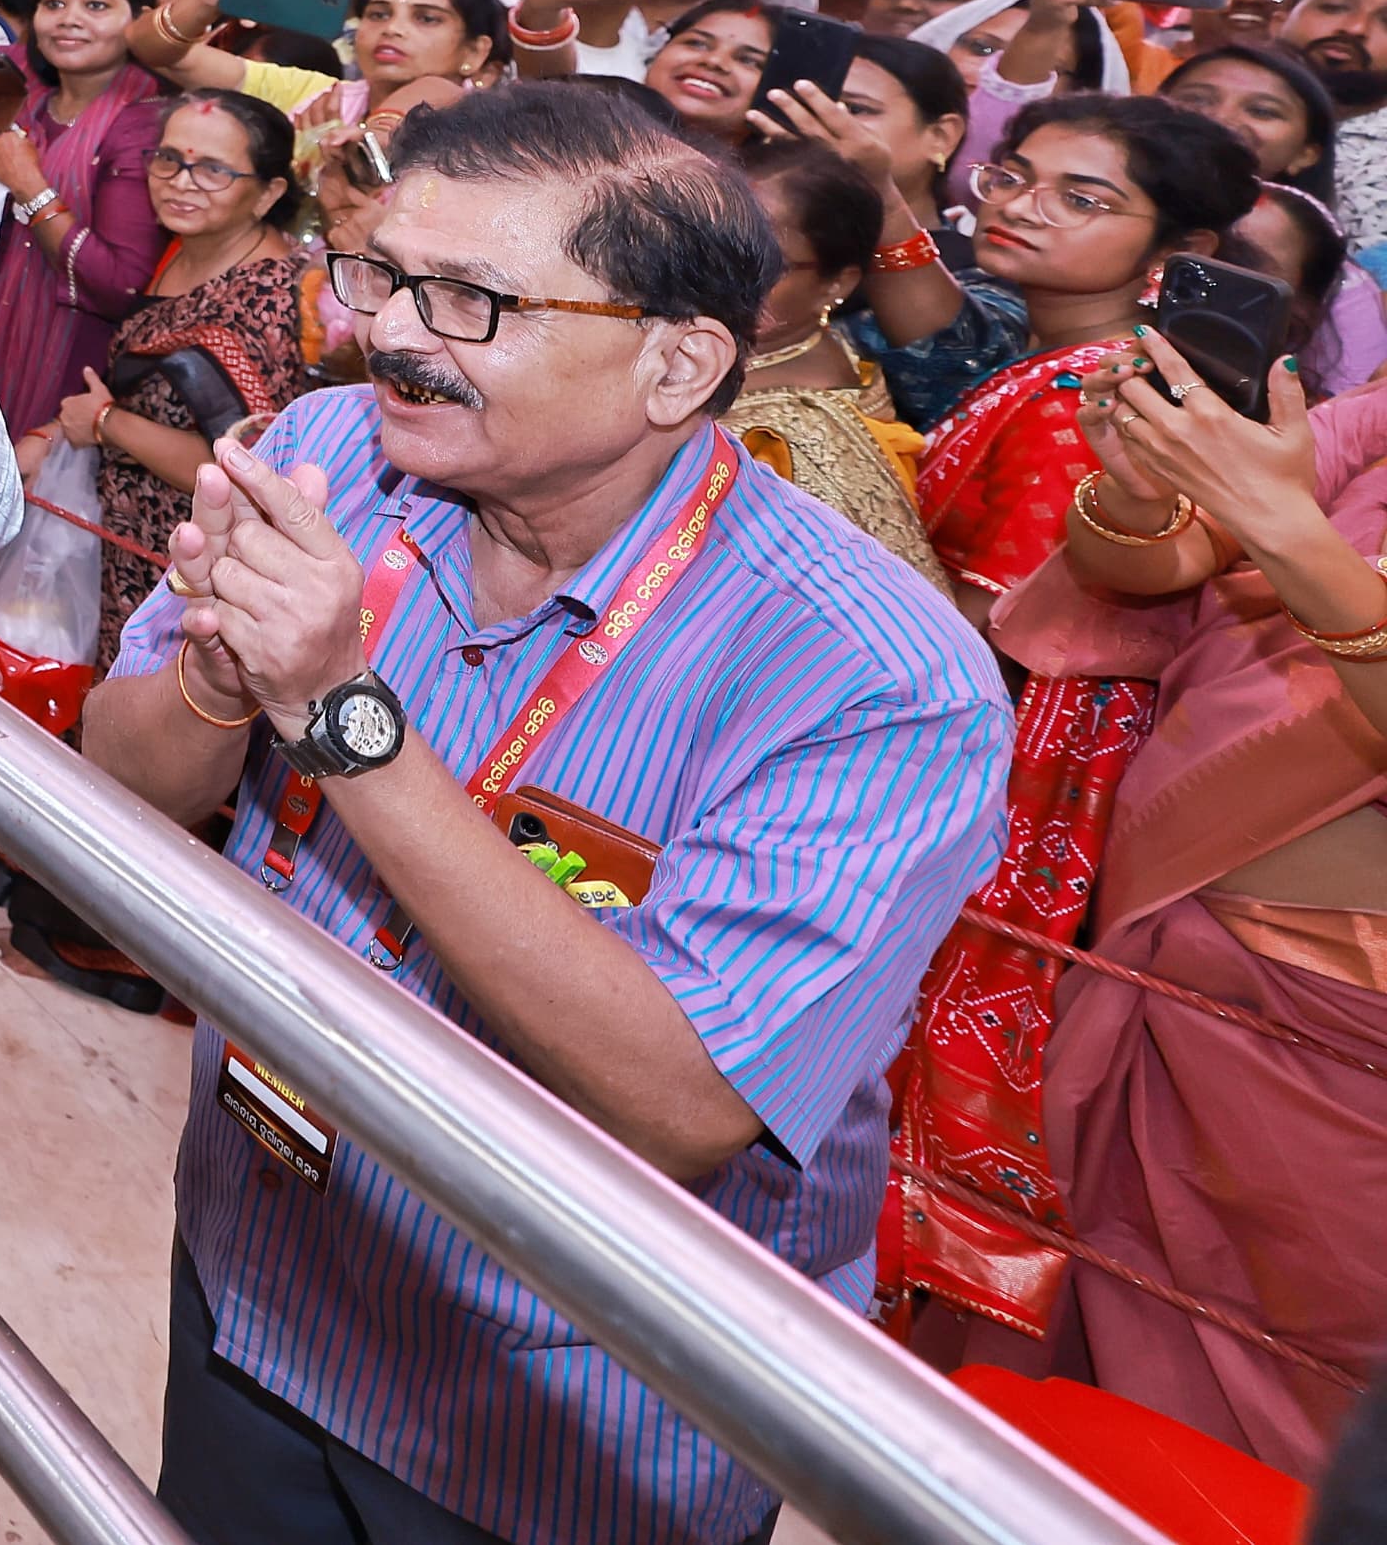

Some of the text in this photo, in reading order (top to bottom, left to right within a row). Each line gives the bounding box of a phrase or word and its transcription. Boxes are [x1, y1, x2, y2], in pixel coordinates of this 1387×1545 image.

[636, 561, 673, 600] ନଗର
[706, 461, 730, 502] ସମିତି
[524, 696, 556, 736] ସମିତି
[254, 1061, 306, 1111] MEMBER
